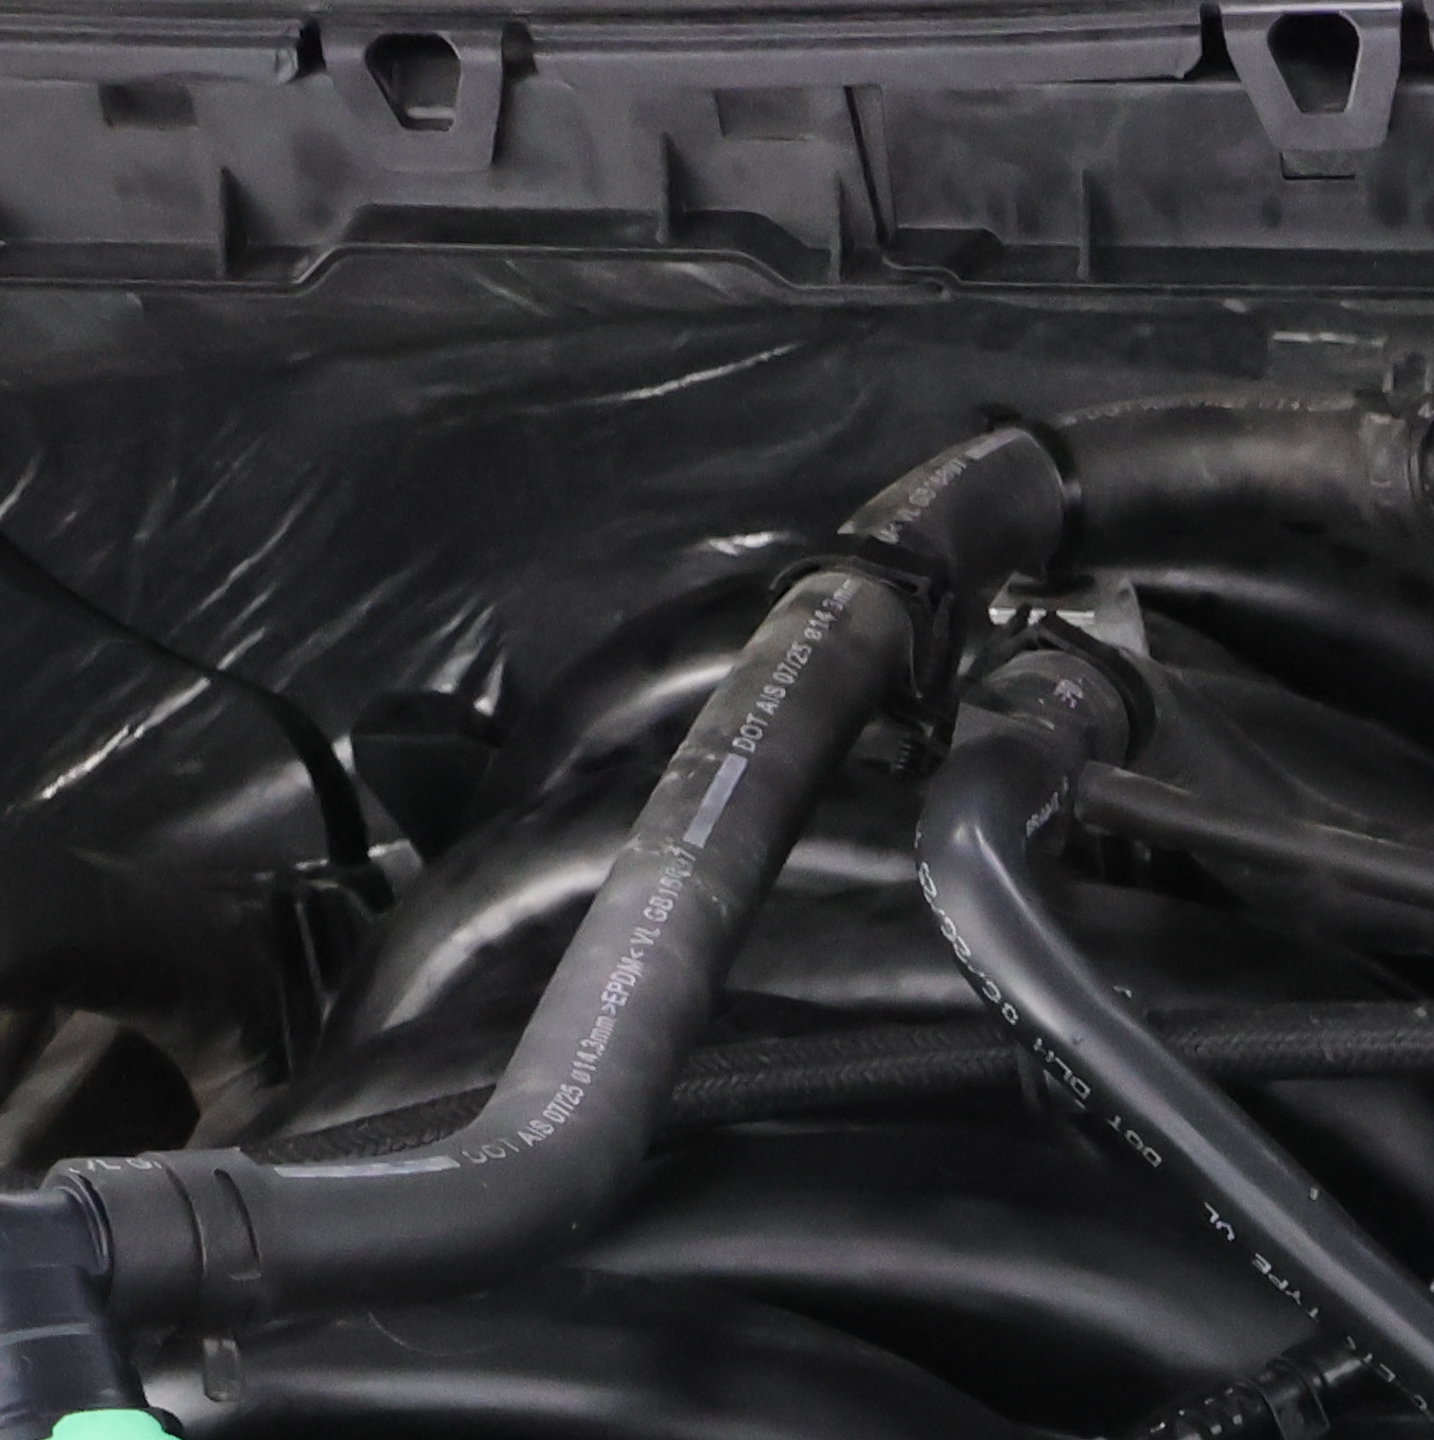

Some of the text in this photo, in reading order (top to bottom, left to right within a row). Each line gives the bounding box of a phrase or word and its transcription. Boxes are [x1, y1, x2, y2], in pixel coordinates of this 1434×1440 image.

[733, 713, 769, 753] DOT
[631, 923, 662, 949] VL
[1108, 1113, 1162, 1168] DOT
[1203, 1203, 1236, 1241] VL
[1251, 1253, 1320, 1321] TYPE
